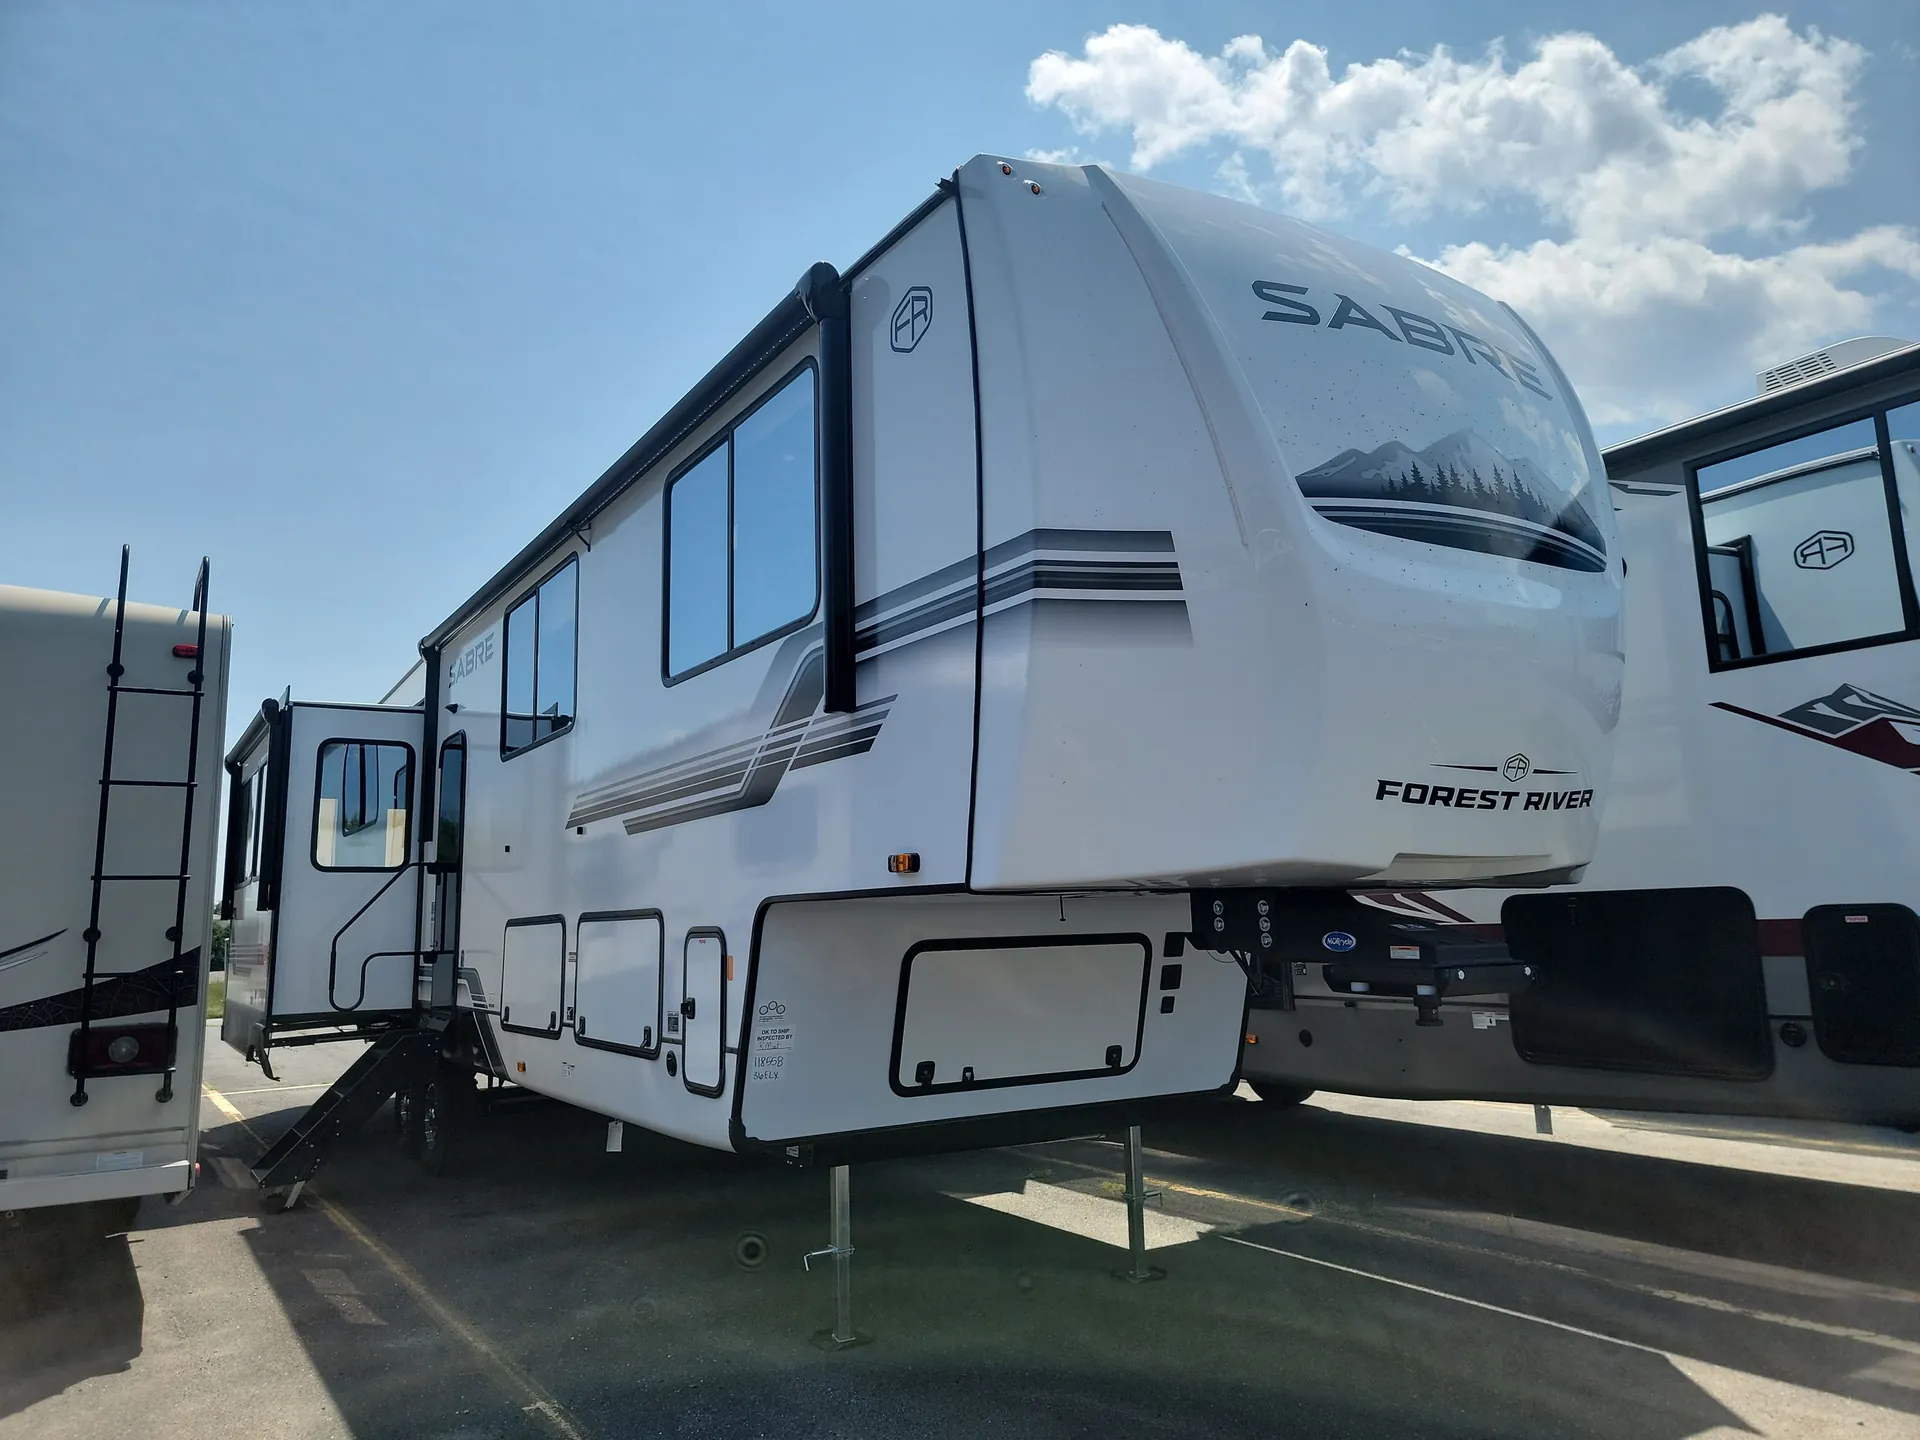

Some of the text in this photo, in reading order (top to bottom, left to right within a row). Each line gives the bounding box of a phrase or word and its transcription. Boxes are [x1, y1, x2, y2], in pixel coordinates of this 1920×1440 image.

[1251, 279, 1554, 402] SABRE
[448, 631, 495, 689] SABRE
[1375, 779, 1594, 811] FOREST RIVER
